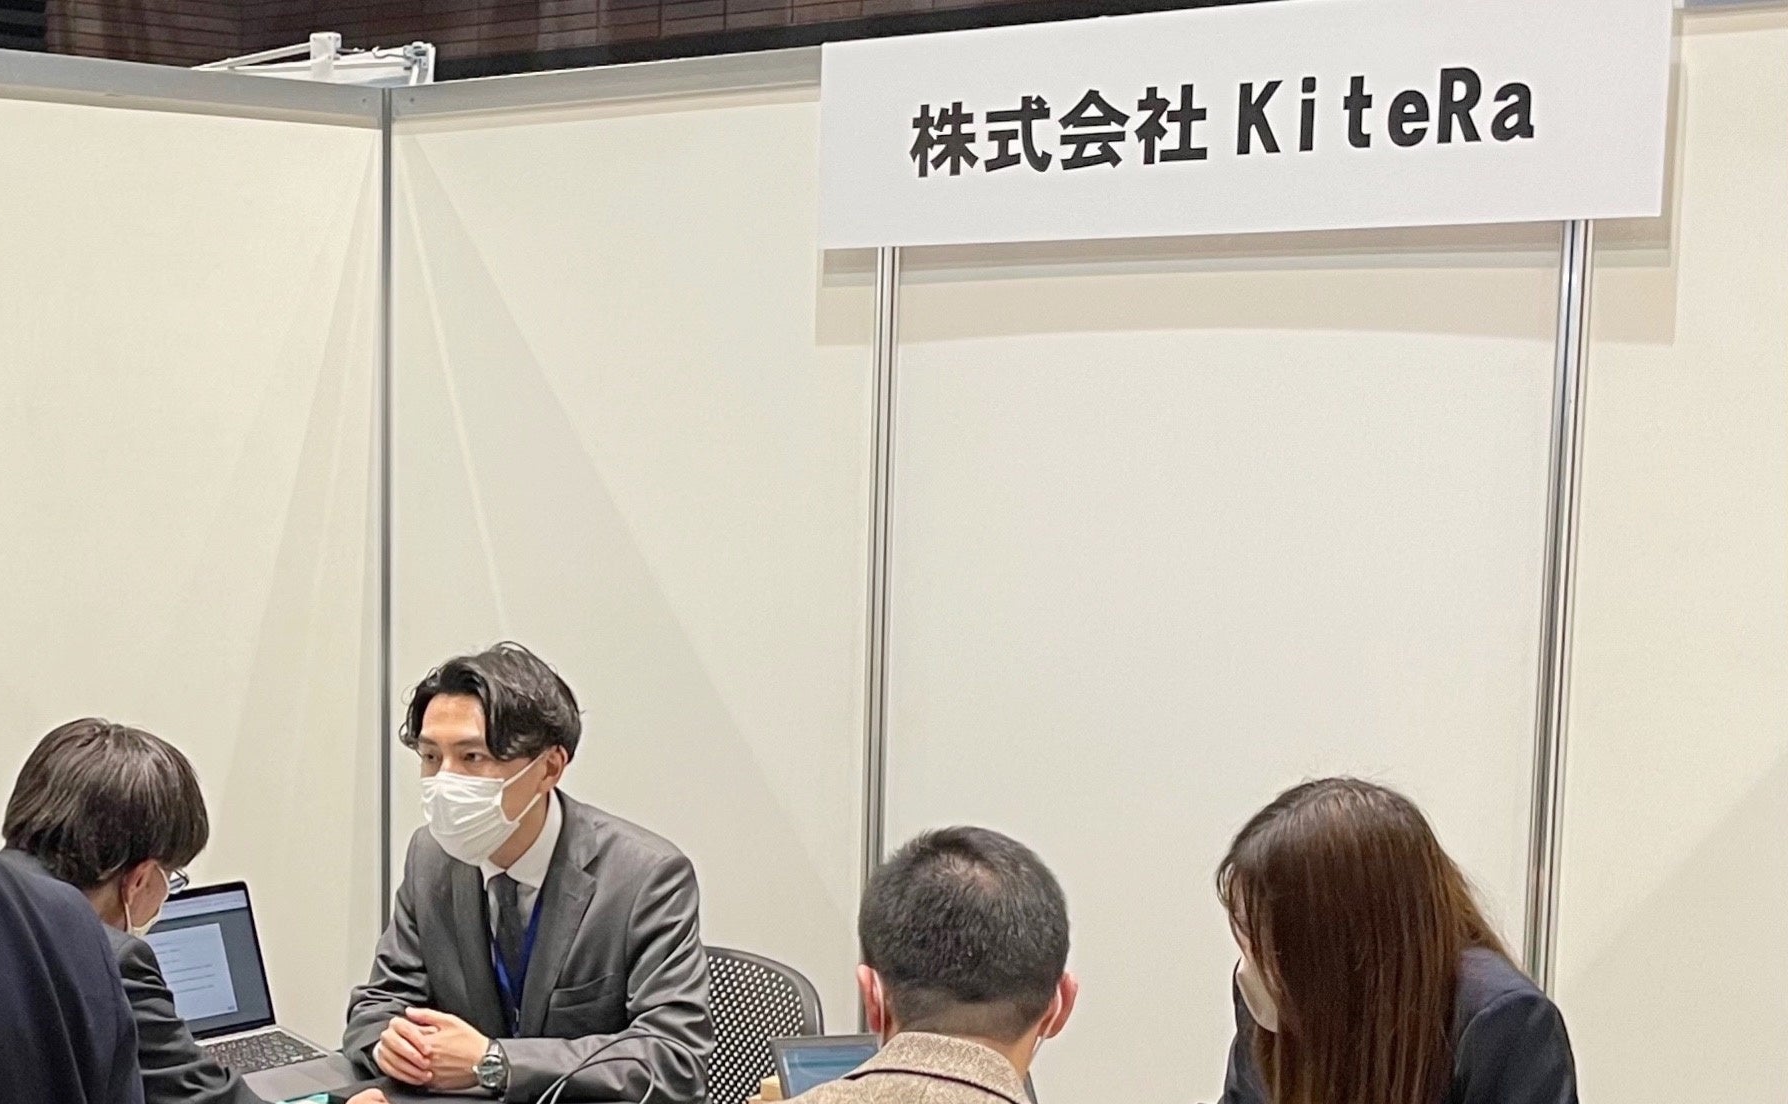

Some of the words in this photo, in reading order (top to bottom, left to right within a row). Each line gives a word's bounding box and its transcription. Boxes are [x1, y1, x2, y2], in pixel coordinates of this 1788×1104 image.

[909, 83, 1208, 178] 株式会社
[1236, 66, 1535, 157] KiteRa
